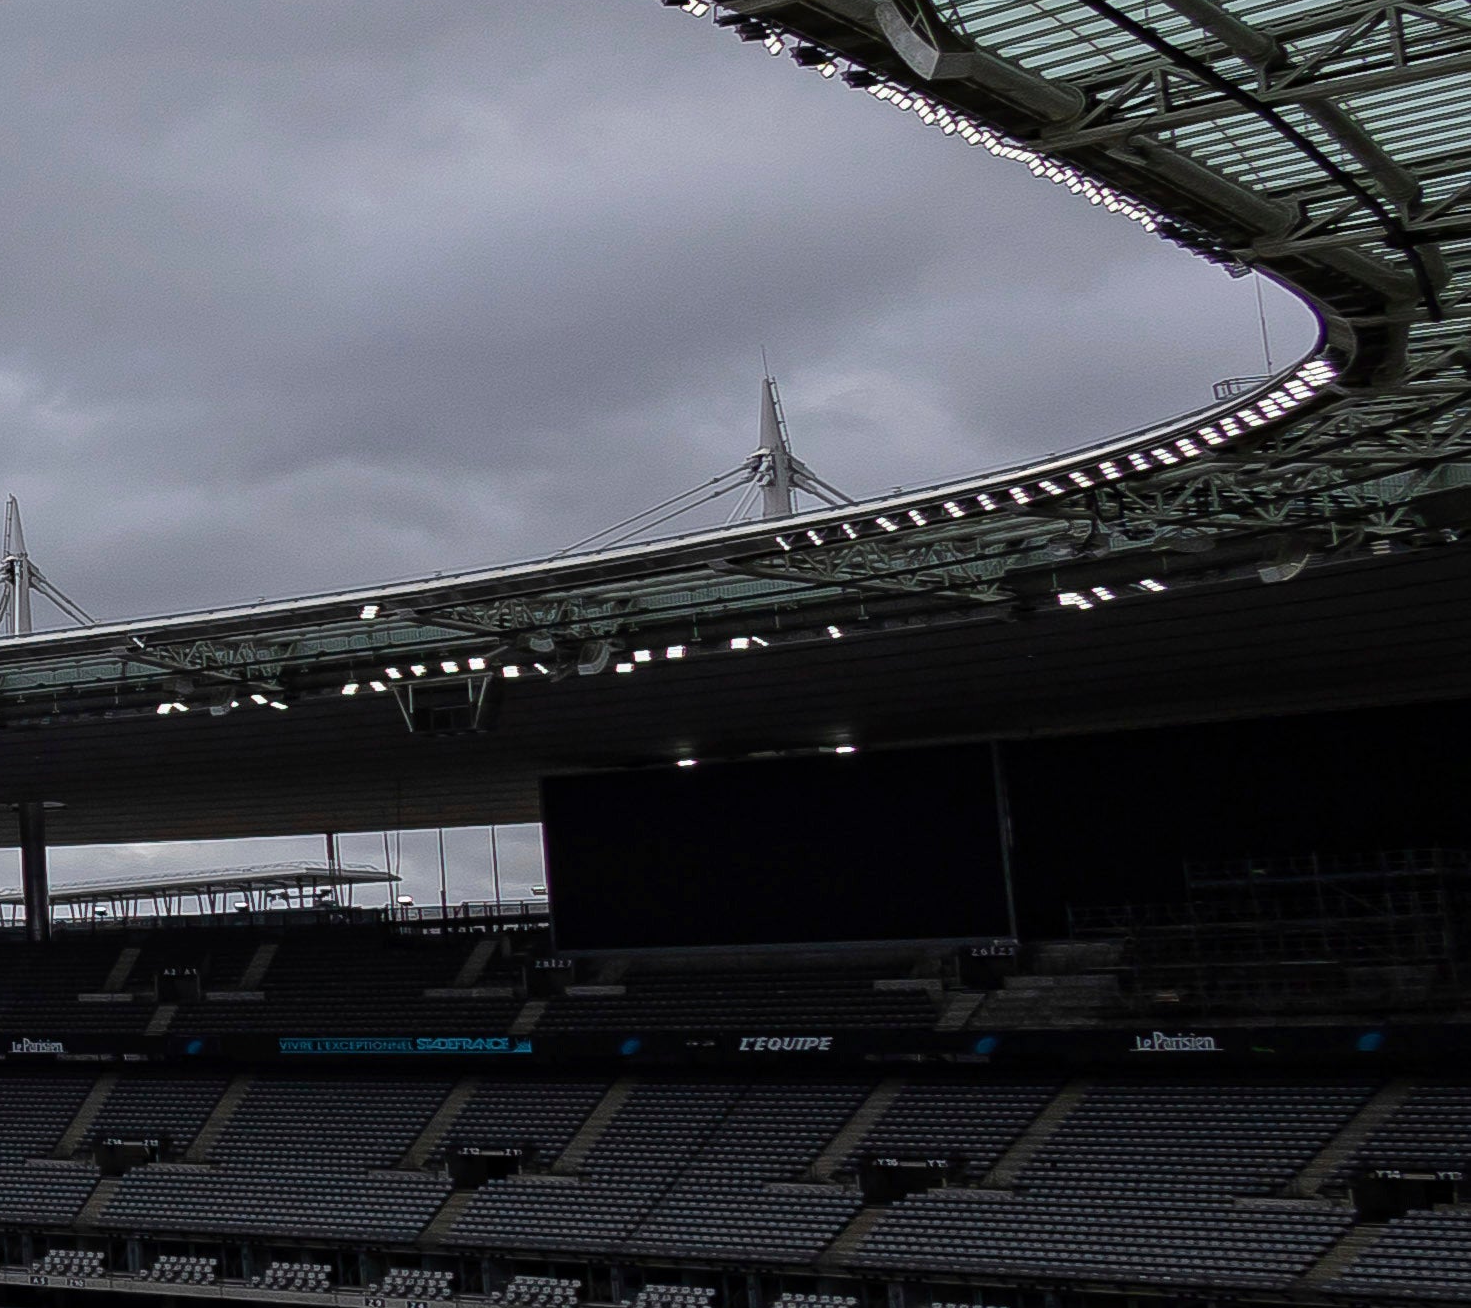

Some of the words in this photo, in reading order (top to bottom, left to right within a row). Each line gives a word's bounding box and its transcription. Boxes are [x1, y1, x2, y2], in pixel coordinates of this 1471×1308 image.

[12, 1041, 22, 1053] Le
[1135, 1035, 1151, 1050] Le
[1152, 1031, 1215, 1050] Parisien
